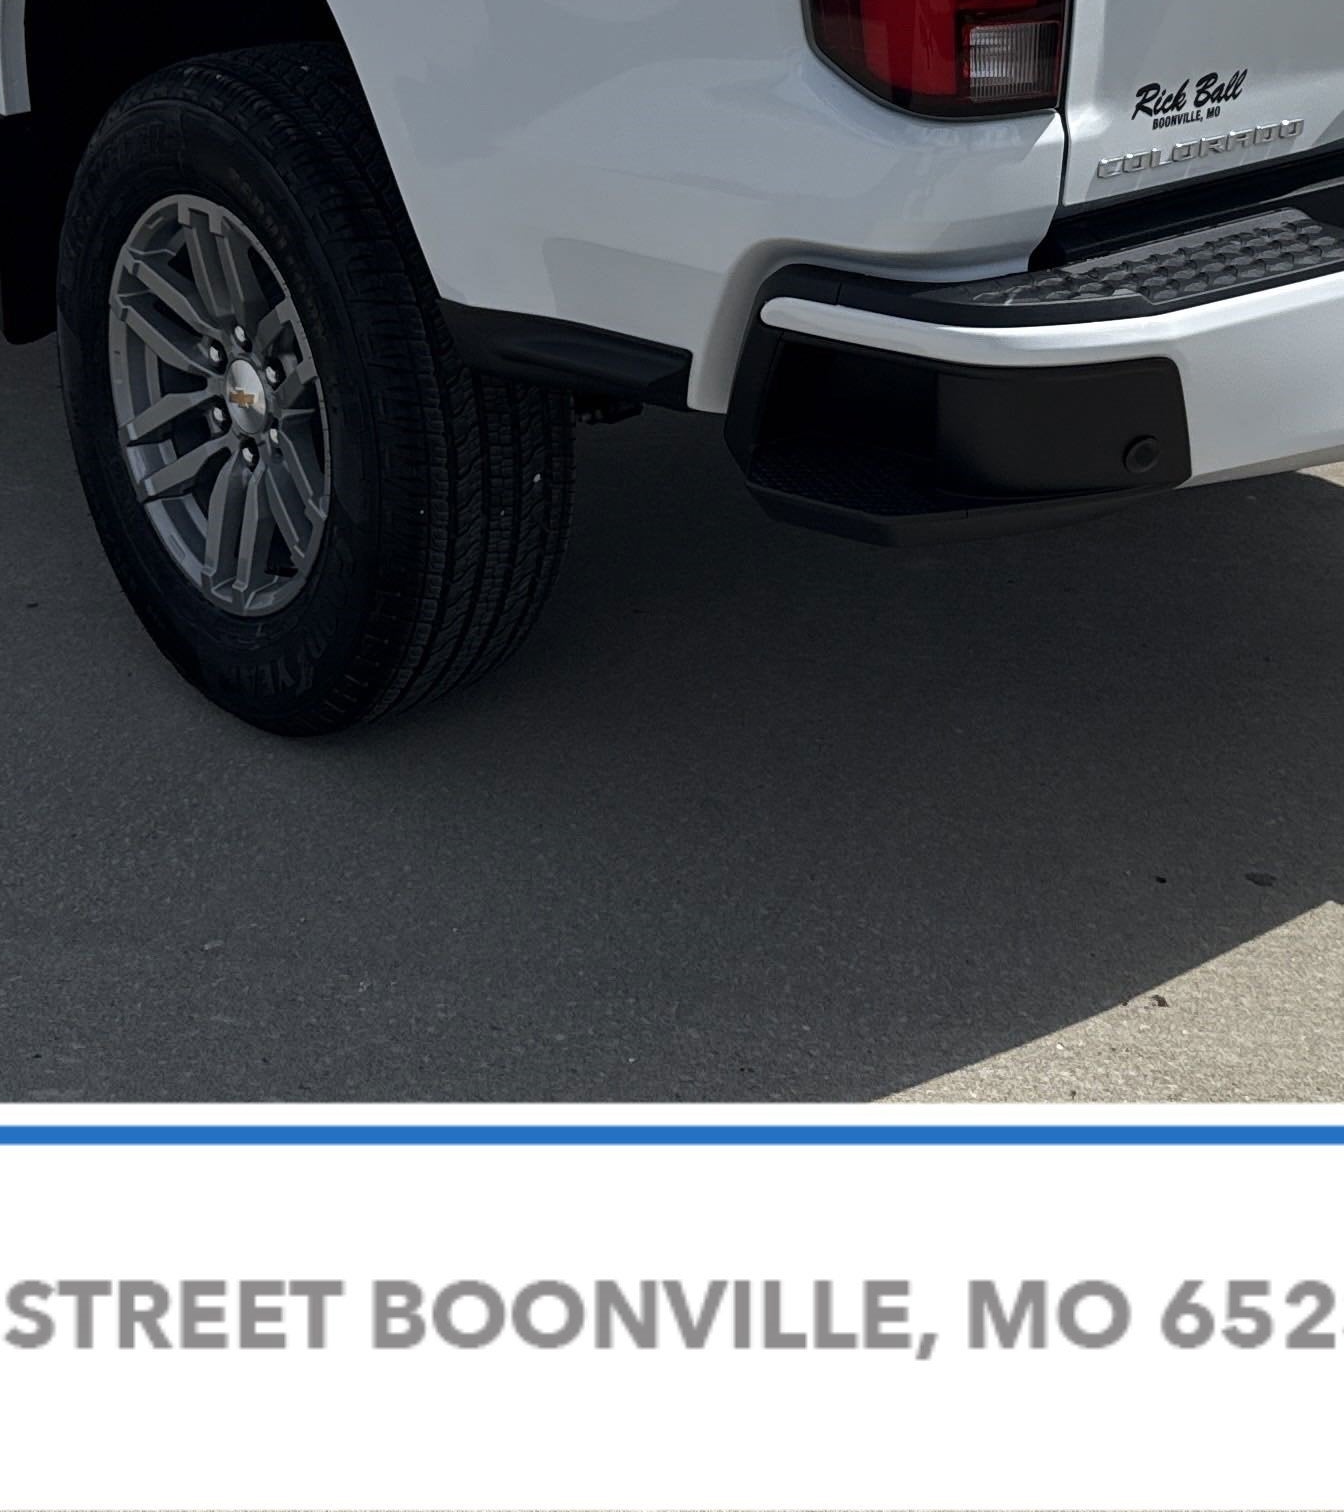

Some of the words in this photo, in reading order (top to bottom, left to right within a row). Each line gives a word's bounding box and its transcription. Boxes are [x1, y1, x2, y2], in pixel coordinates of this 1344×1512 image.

[1131, 79, 1190, 120] Rick
[1193, 68, 1248, 108] Ball
[1152, 109, 1204, 130] BOONVILLE,
[1206, 105, 1221, 119] MO
[1097, 118, 1305, 179] COLORADO
